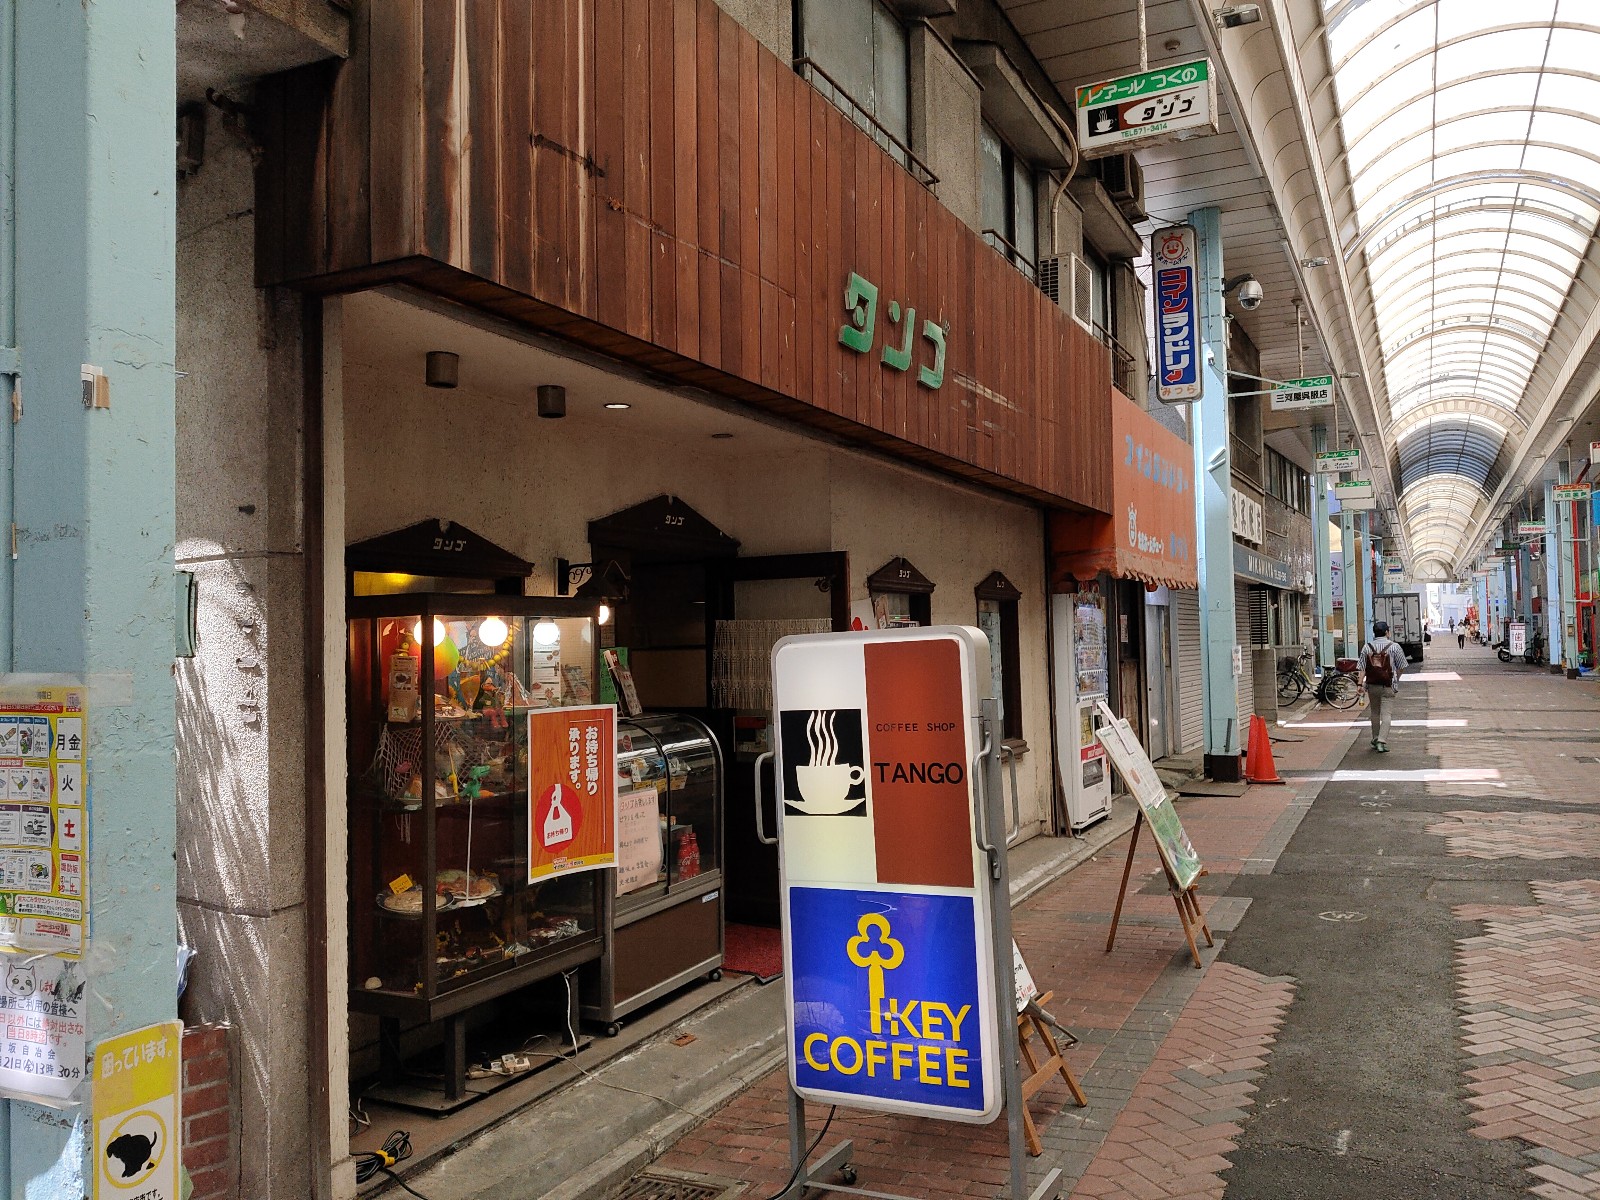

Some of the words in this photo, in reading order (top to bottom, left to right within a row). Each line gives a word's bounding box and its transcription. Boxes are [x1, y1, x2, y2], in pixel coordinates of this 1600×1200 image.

[1087, 78, 1146, 103] レアール
[1150, 67, 1198, 88] つくの
[1141, 95, 1196, 122] タンゴ
[838, 271, 950, 390] タンゴ
[1276, 389, 1328, 403] 三河屋呉服店
[665, 514, 685, 526] タンゴ
[433, 537, 466, 552] タンゴ
[1514, 632, 1523, 652] 歯科
[876, 722, 919, 732] COFFEE
[927, 722, 956, 732] SHOP
[568, 727, 581, 790] 承ります。
[585, 726, 599, 796] お持ち帰り
[61, 774, 74, 792] 火
[873, 762, 964, 785] TANGO
[64, 818, 76, 839] 土
[546, 827, 569, 840] お持ち帰り
[884, 998, 972, 1042] KEY
[0, 1042, 56, 1060] 坂自治会
[101, 1037, 174, 1079] 困っています。
[803, 1032, 970, 1089] COFFEE
